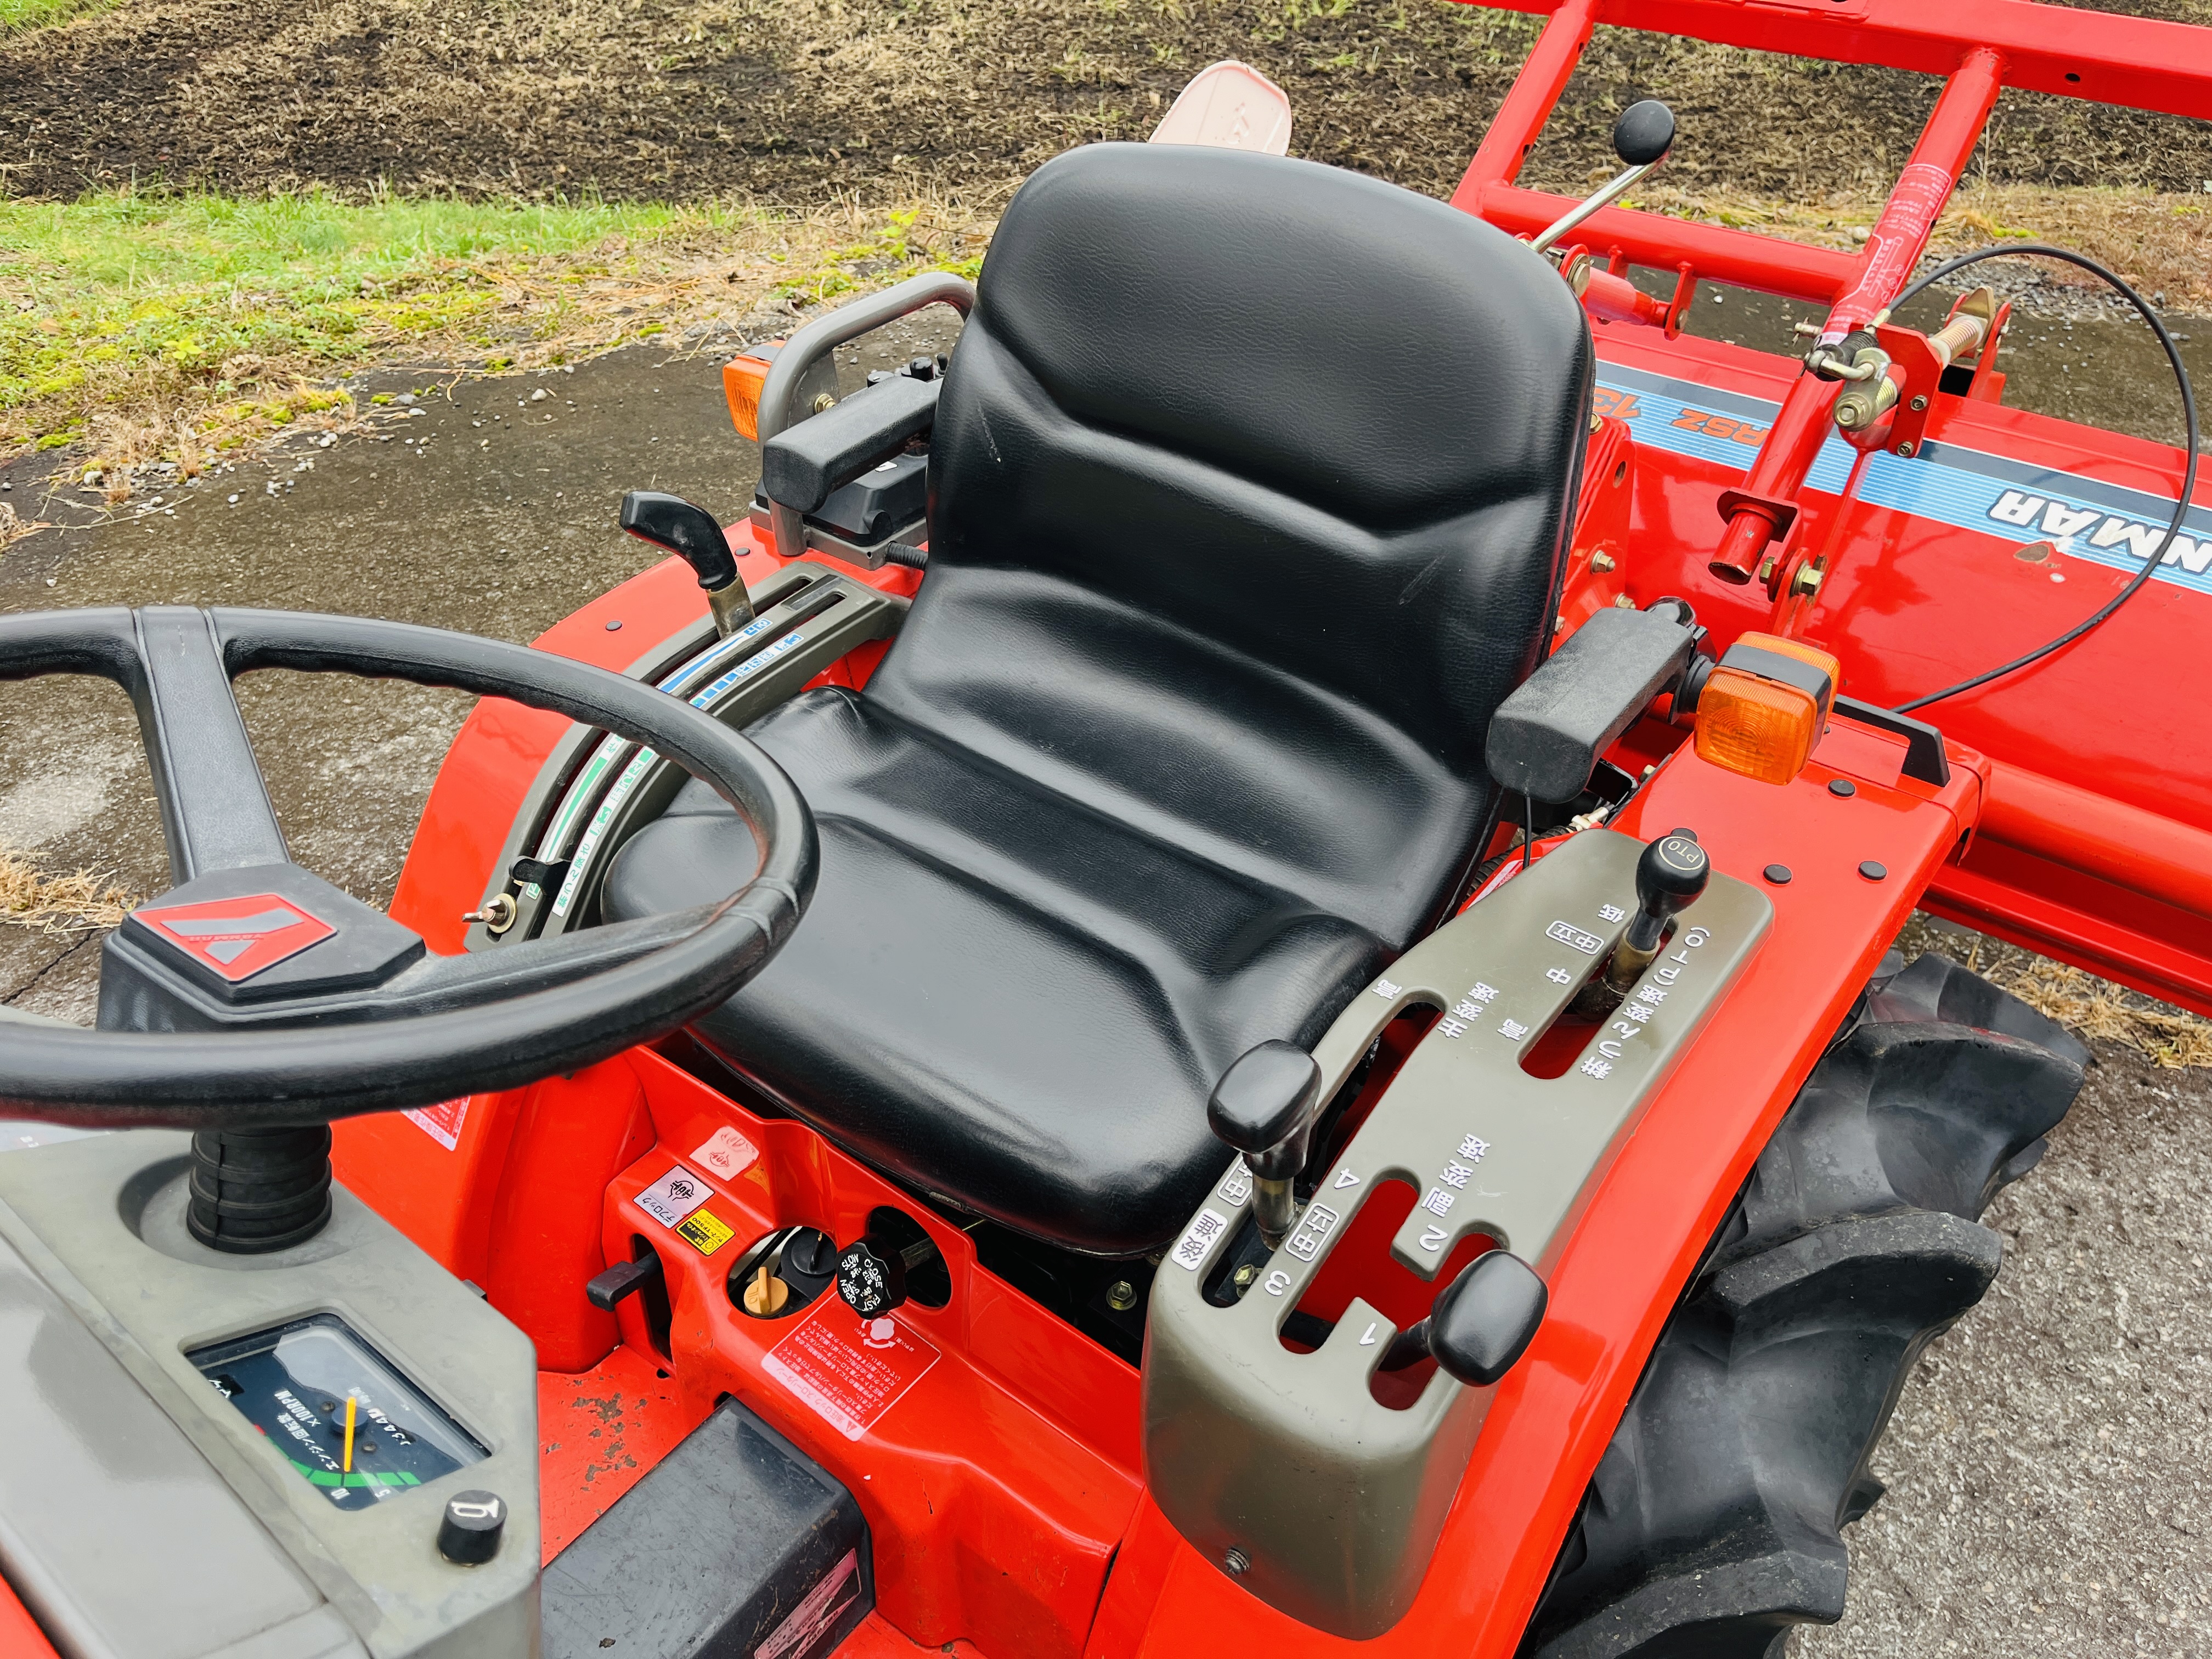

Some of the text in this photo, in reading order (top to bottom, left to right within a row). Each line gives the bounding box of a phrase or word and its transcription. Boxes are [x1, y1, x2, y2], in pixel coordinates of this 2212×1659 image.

[1672, 408, 1771, 447] RSZ
[610, 762, 642, 802] 耕うん
[590, 806, 612, 836] 深い
[1668, 841, 1700, 863] PTO
[557, 843, 590, 908] 耕うん深さ
[1598, 903, 1626, 923] 低
[1553, 923, 1595, 949] 中立
[1372, 979, 1402, 1000] 高
[1545, 968, 1572, 985] 中
[1437, 982, 1499, 1039] 主変速
[1497, 1018, 1529, 1041] 高
[1333, 1168, 1361, 1190] 4
[1421, 1133, 1491, 1218] 副変速
[642, 1197, 675, 1223] デフロック
[691, 1217, 710, 1233] TF500
[1180, 1213, 1224, 1262] 後進
[1292, 1208, 1334, 1253] 中立
[1419, 1224, 1449, 1252] 2
[842, 1254, 859, 1271] SLOW
[864, 1259, 883, 1289] CLOSE
[747, 1287, 759, 1304] OIL
[840, 1279, 856, 1304] OPEN
[1264, 1269, 1291, 1296] 3
[862, 1294, 881, 1311] FAST
[1359, 1322, 1376, 1346] 1
[277, 1412, 340, 1470] エンジン回転数
[331, 1487, 351, 1500] 10
